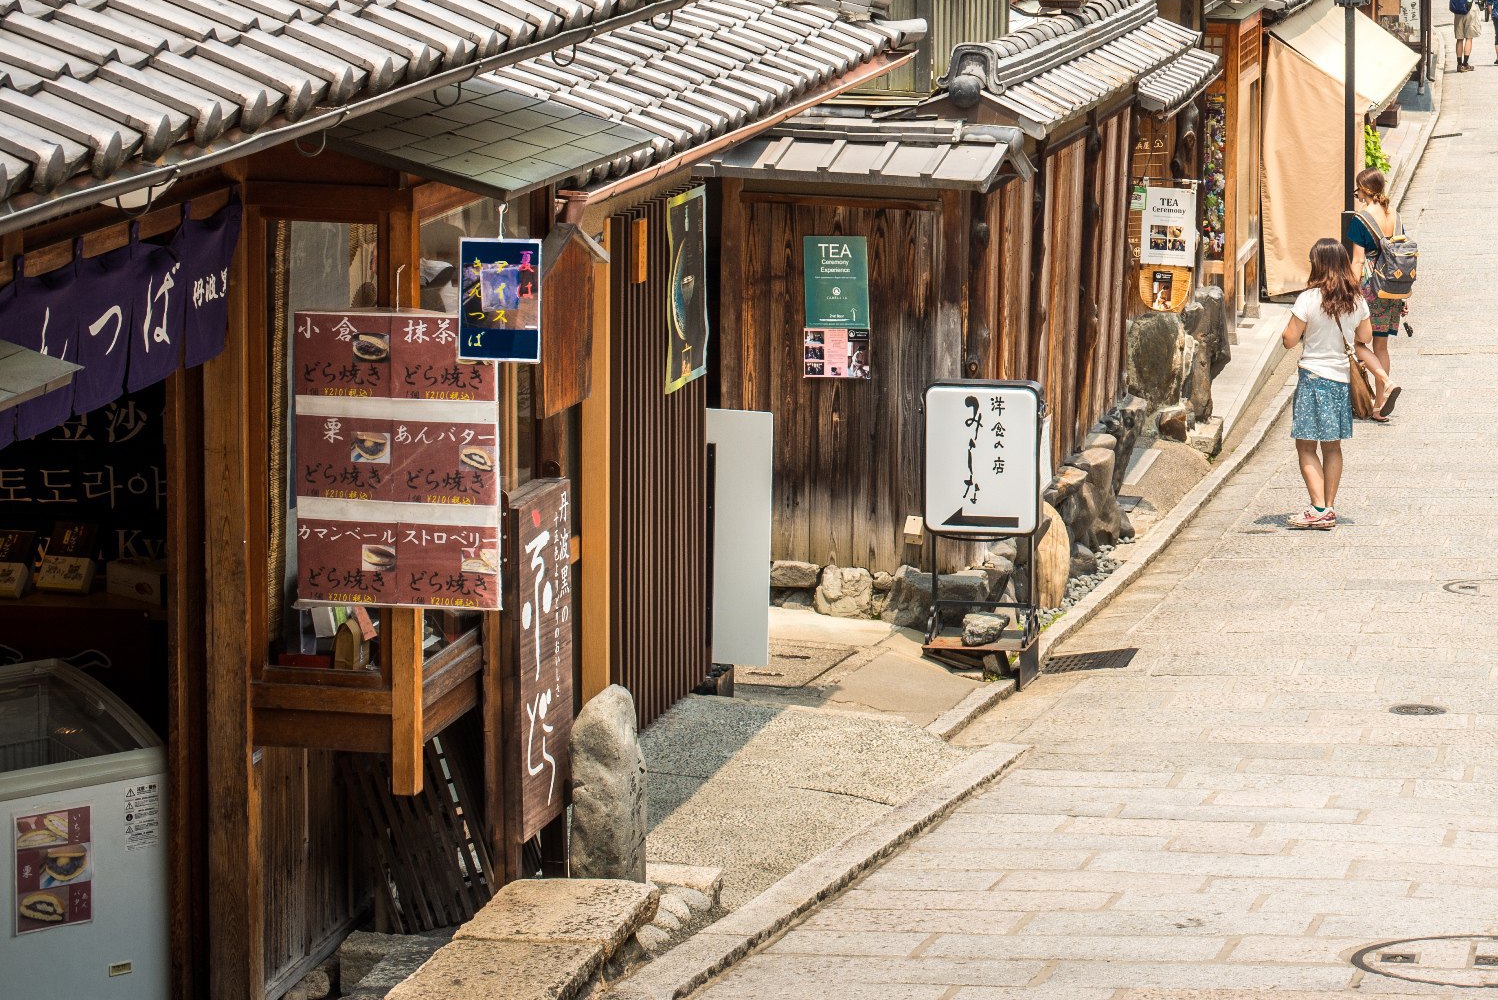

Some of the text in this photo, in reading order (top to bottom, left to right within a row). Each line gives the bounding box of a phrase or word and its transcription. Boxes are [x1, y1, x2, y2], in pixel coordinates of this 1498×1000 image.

[1152, 205, 1187, 215] Ceremony
[1159, 197, 1179, 207] TEA
[817, 243, 852, 258] TEA
[821, 259, 850, 267] Ceremony
[517, 250, 535, 300] 夏は
[820, 266, 850, 274] Experience
[467, 256, 486, 347] きんつば
[492, 260, 509, 323] アイス
[298, 316, 359, 342] 小倉
[402, 319, 456, 345] 抹茶
[304, 361, 381, 387] どら焼き
[404, 364, 483, 390] どら焼き
[323, 417, 344, 444] 栗
[394, 424, 496, 446] あんバター
[990, 396, 1006, 475] 洋食の店
[964, 395, 983, 504] みしな
[304, 462, 381, 489] どら焼き
[406, 468, 485, 495] どら焼き
[298, 524, 397, 544] カマンベール
[402, 529, 498, 549] ストロベリー
[558, 490, 570, 623] 丹波黒の
[308, 566, 385, 592] どら焼き
[410, 570, 488, 597] どら焼き
[73, 813, 81, 842] いちご
